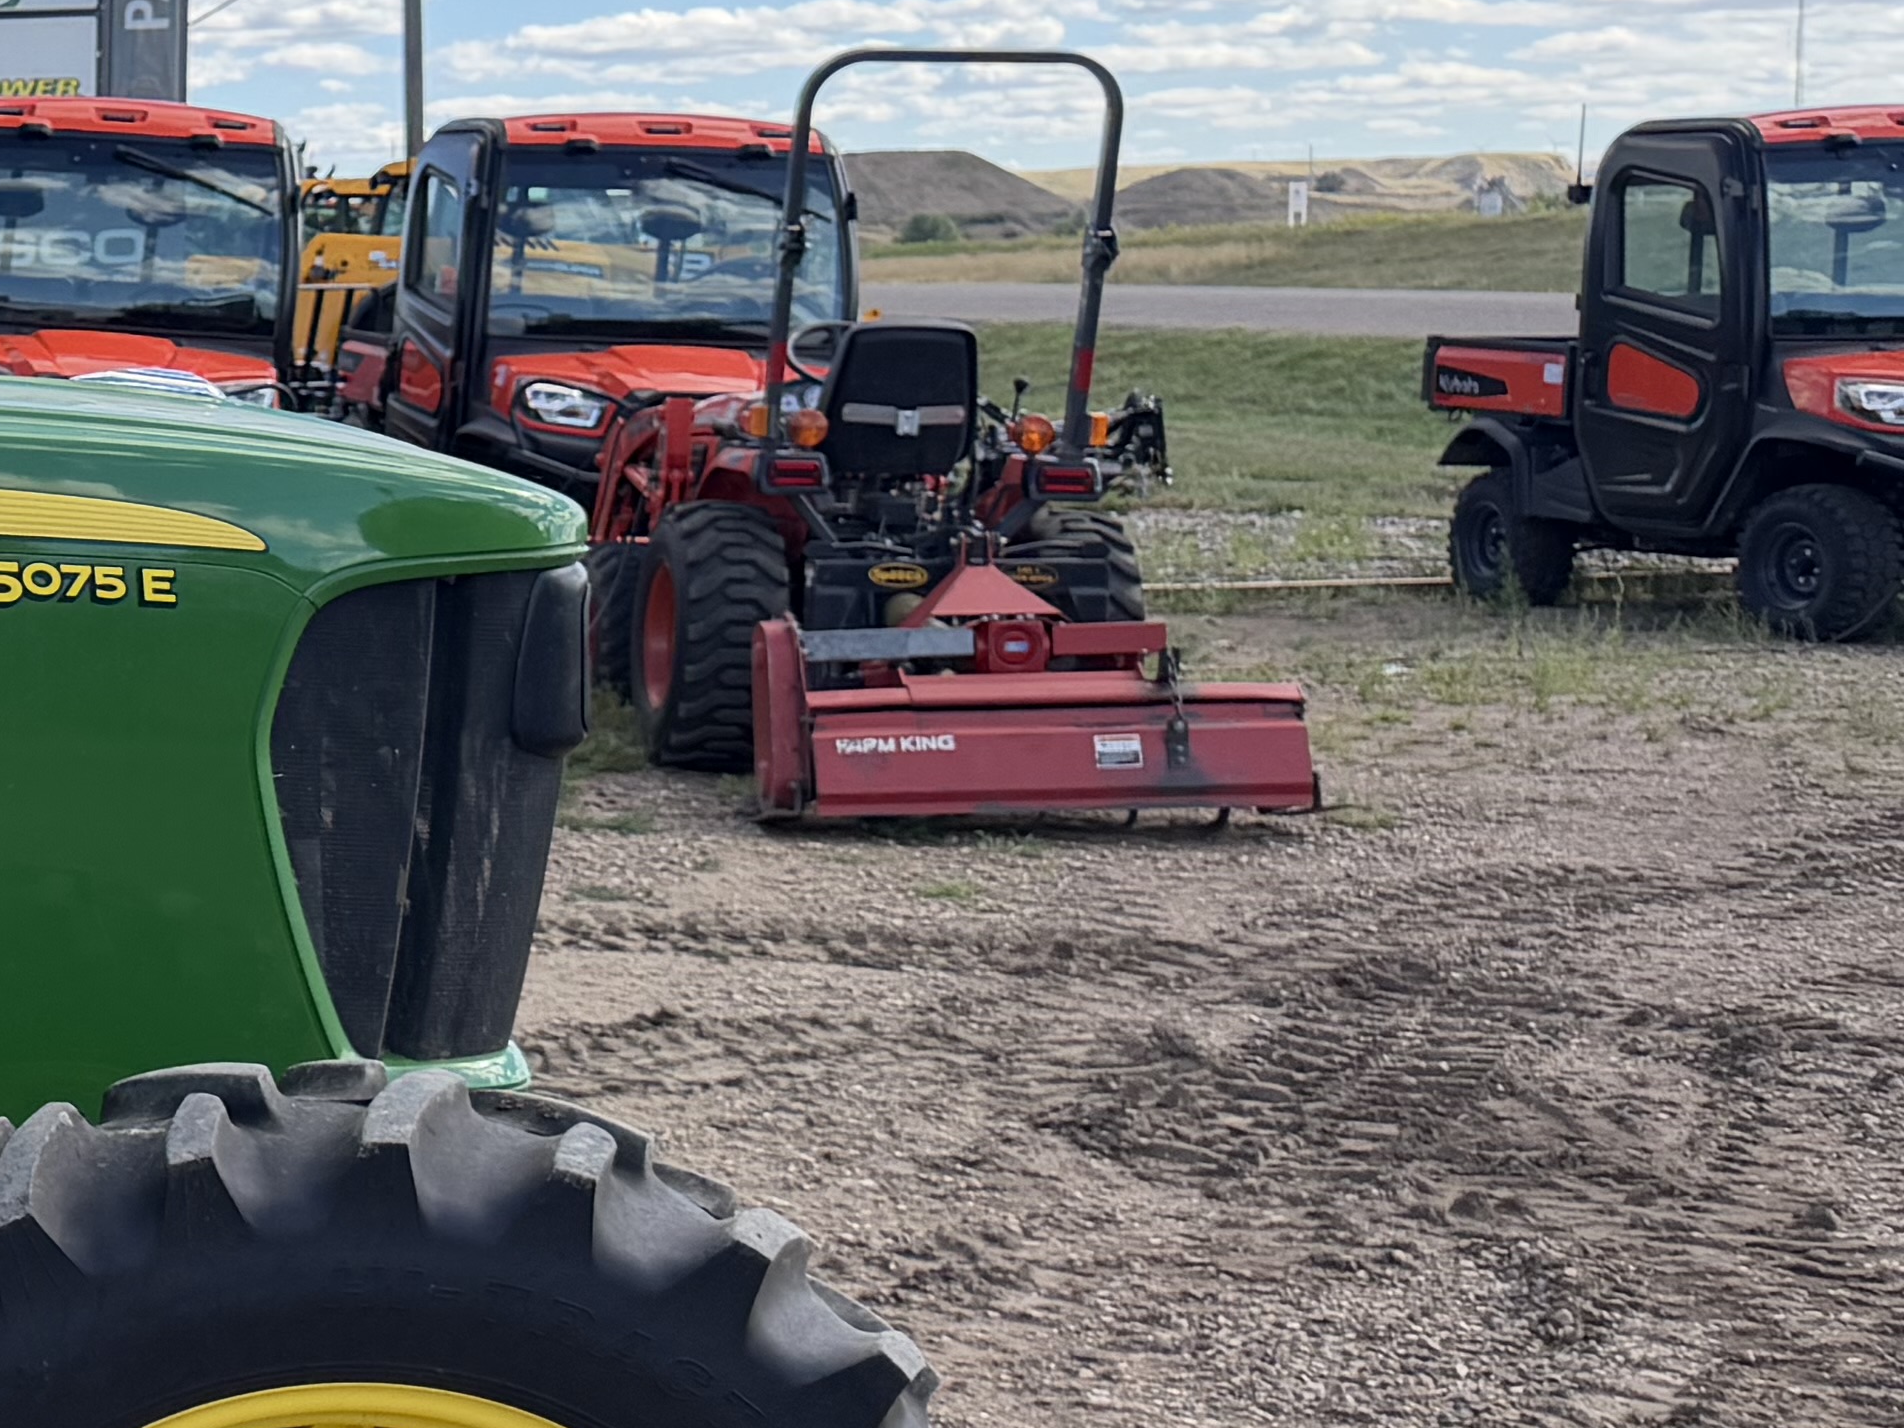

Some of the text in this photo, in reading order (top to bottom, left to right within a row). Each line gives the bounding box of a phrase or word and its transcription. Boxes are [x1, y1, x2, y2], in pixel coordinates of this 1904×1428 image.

[140, 567, 178, 604] E
[835, 734, 956, 755] FARM KING
